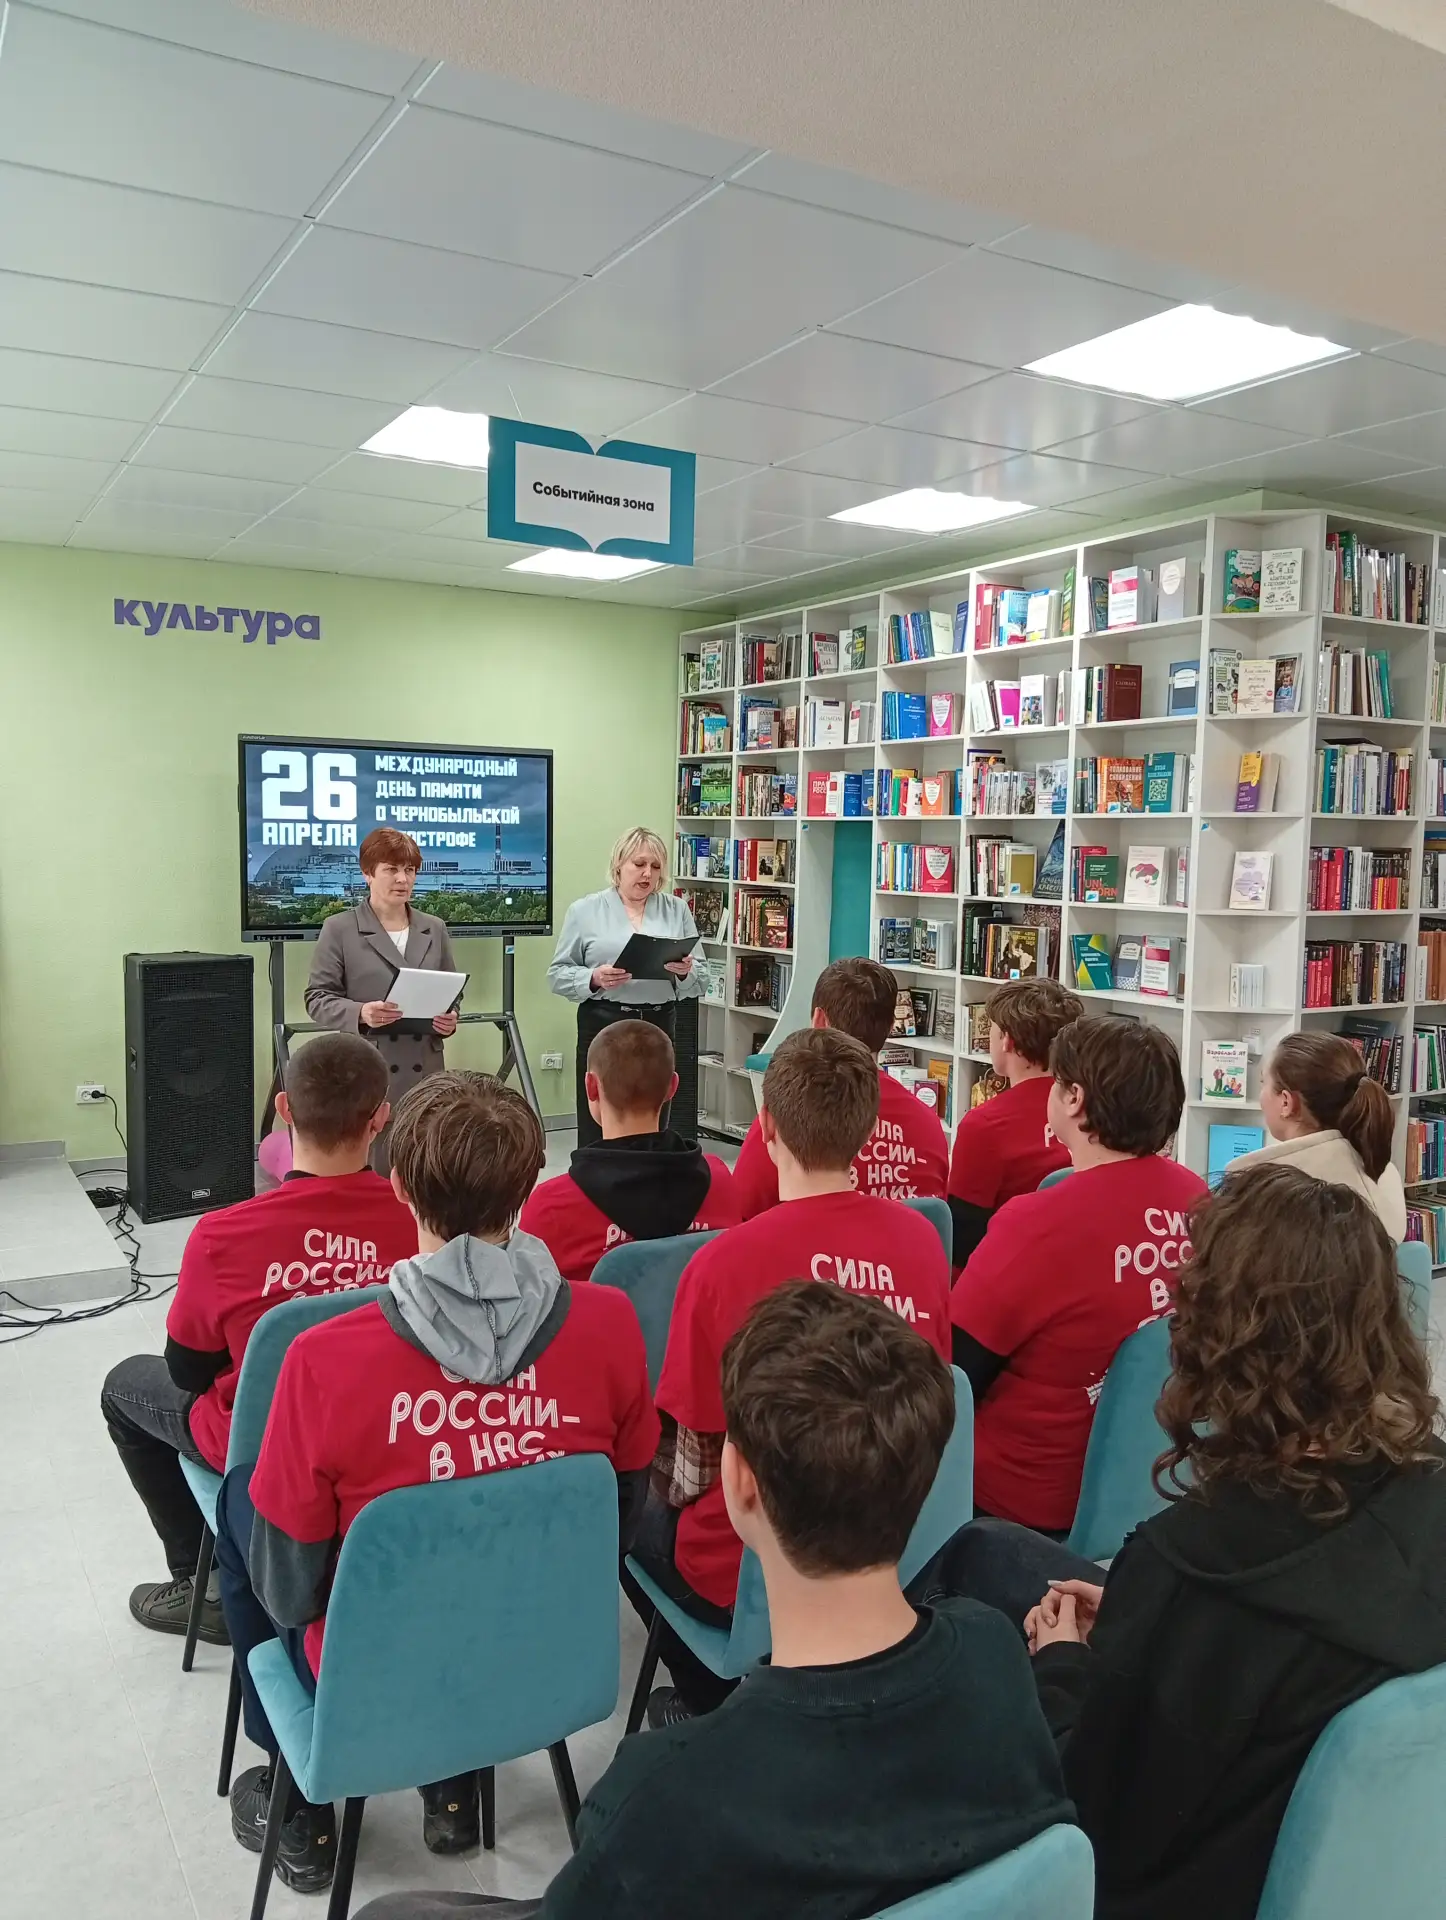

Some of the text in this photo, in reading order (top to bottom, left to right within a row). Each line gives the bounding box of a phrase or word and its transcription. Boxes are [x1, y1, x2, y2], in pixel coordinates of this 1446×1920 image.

[532, 481, 655, 512] Событийная зона
[114, 598, 320, 645] культура
[375, 754, 518, 777] МЕЖДУНАРОДНЫЙ
[261, 750, 357, 821] 26
[376, 780, 482, 799] ДЕНЬ ПАМЯТИ
[375, 806, 520, 824] О ЧЕРНОБЫЛЬСКОЙ
[262, 823, 357, 846] АПРЕЛЯ
[858, 1141, 927, 1165] ССИИ-
[867, 1164, 910, 1185] НАС
[304, 1228, 378, 1262] СИЛА
[810, 1253, 895, 1292] СИЛА
[1149, 1278, 1170, 1311] В
[388, 1389, 580, 1444] РОССИИ-
[430, 1441, 456, 1482] В
[469, 1430, 546, 1472] НАС
